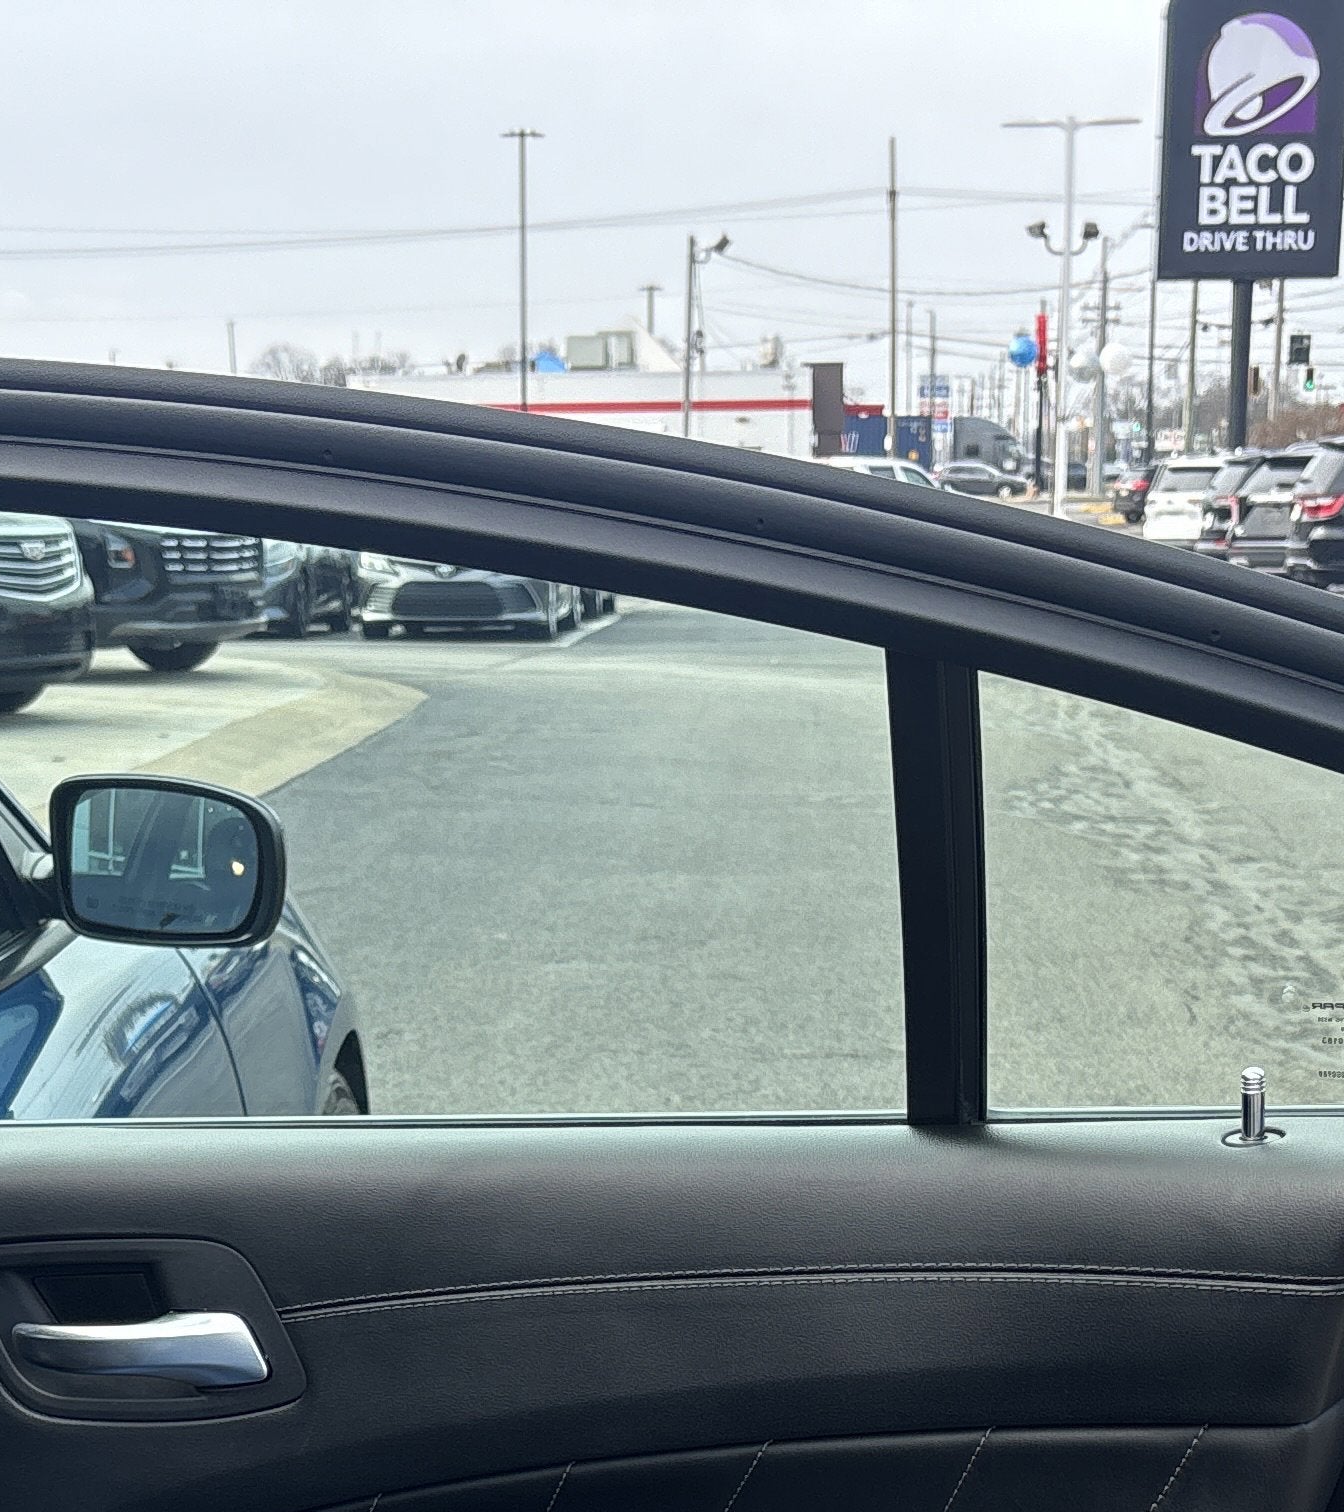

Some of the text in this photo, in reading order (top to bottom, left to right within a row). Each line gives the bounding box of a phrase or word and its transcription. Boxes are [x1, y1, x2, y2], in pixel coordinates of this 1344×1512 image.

[1191, 142, 1315, 184] TACO
[1198, 185, 1310, 225] BELL
[1183, 229, 1315, 252] DRIVE THRU
